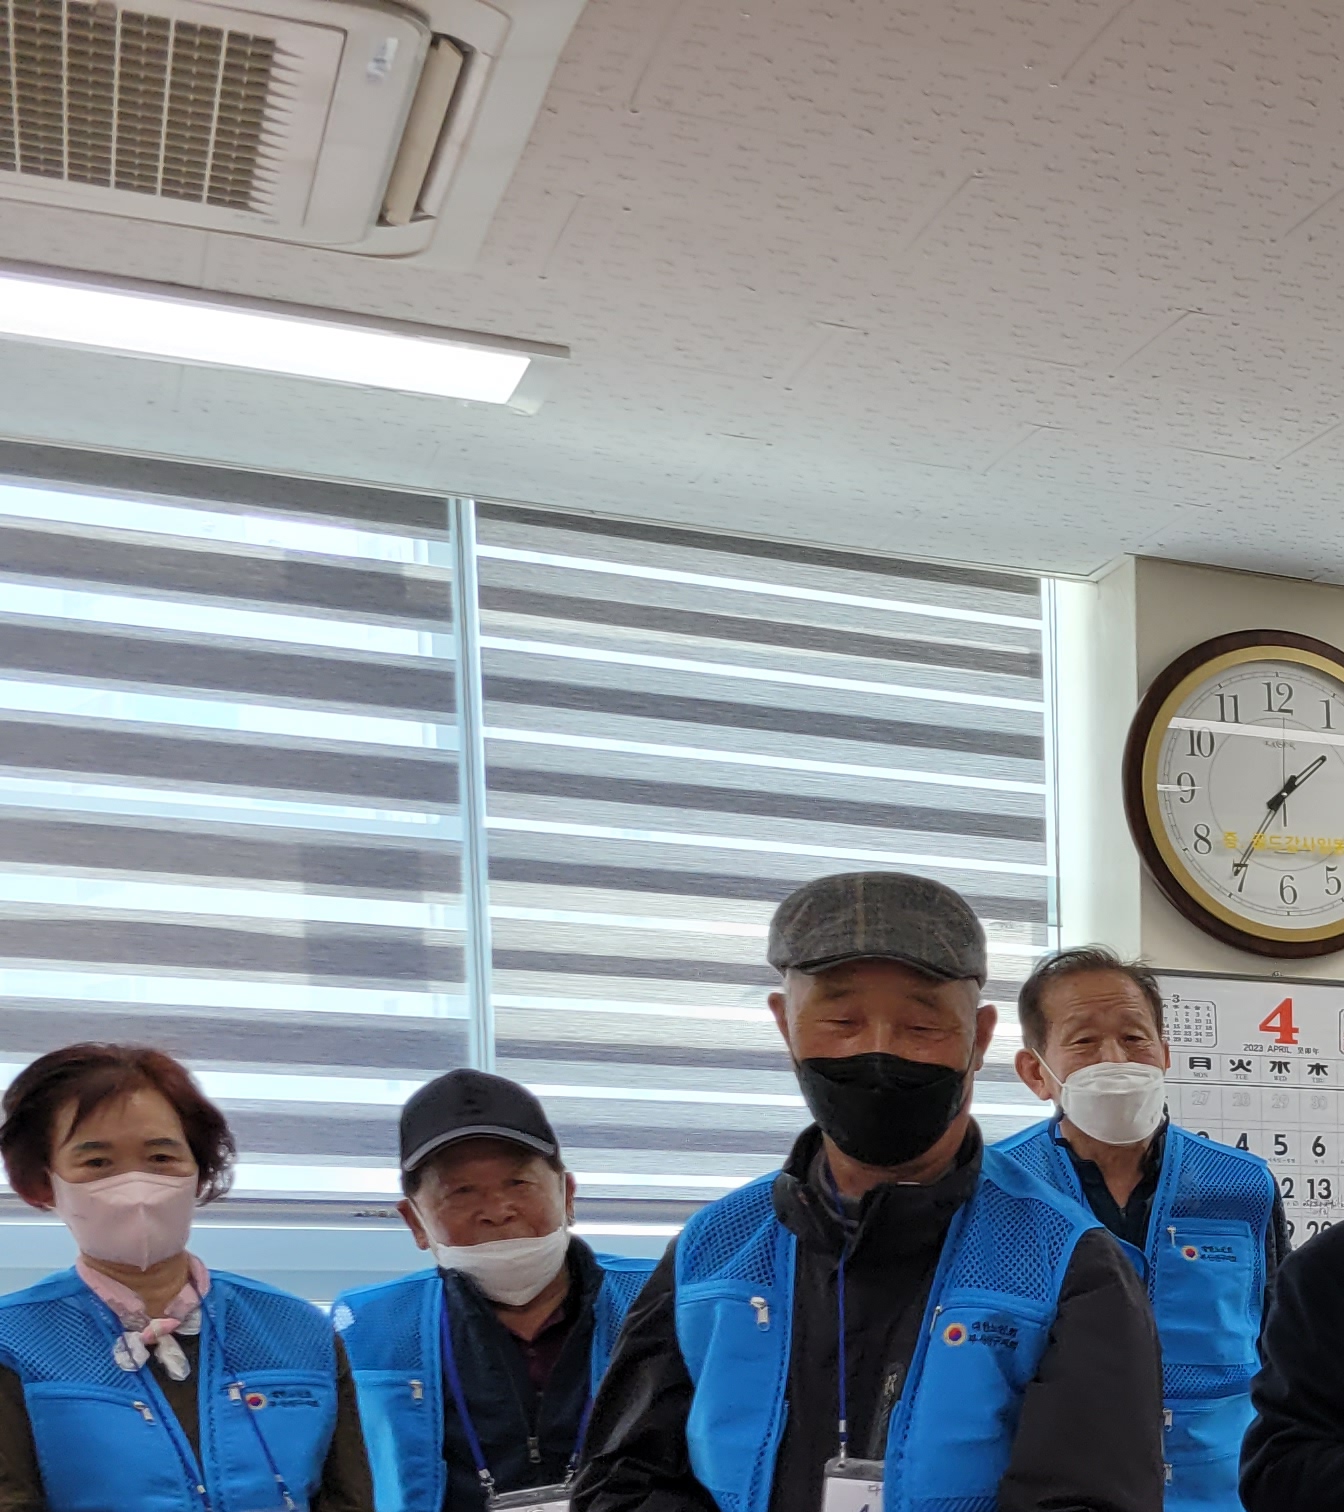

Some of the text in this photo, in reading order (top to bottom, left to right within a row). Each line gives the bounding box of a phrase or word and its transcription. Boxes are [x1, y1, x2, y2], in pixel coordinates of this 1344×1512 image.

[1214, 692, 1243, 724] 11
[1261, 681, 1294, 716] 12
[1319, 698, 1336, 730] 1
[1184, 725, 1216, 759] 10
[1175, 771, 1197, 804] 9
[1192, 822, 1213, 856] 8
[1278, 873, 1299, 906] 6
[1324, 864, 1343, 896] 5
[1171, 993, 1181, 1004] 3
[1258, 997, 1300, 1045] 4
[1242, 1043, 1293, 1055] 2023 APRIL
[1188, 1056, 1212, 1071] 月
[1229, 1058, 1253, 1074] 火
[1269, 1060, 1291, 1075] 水
[1307, 1062, 1329, 1077] 木
[1191, 1090, 1211, 1107] 27
[1235, 1132, 1250, 1151] 4
[1273, 1133, 1289, 1156] 5
[1311, 1135, 1326, 1158] 6
[1306, 1177, 1332, 1200] 13
